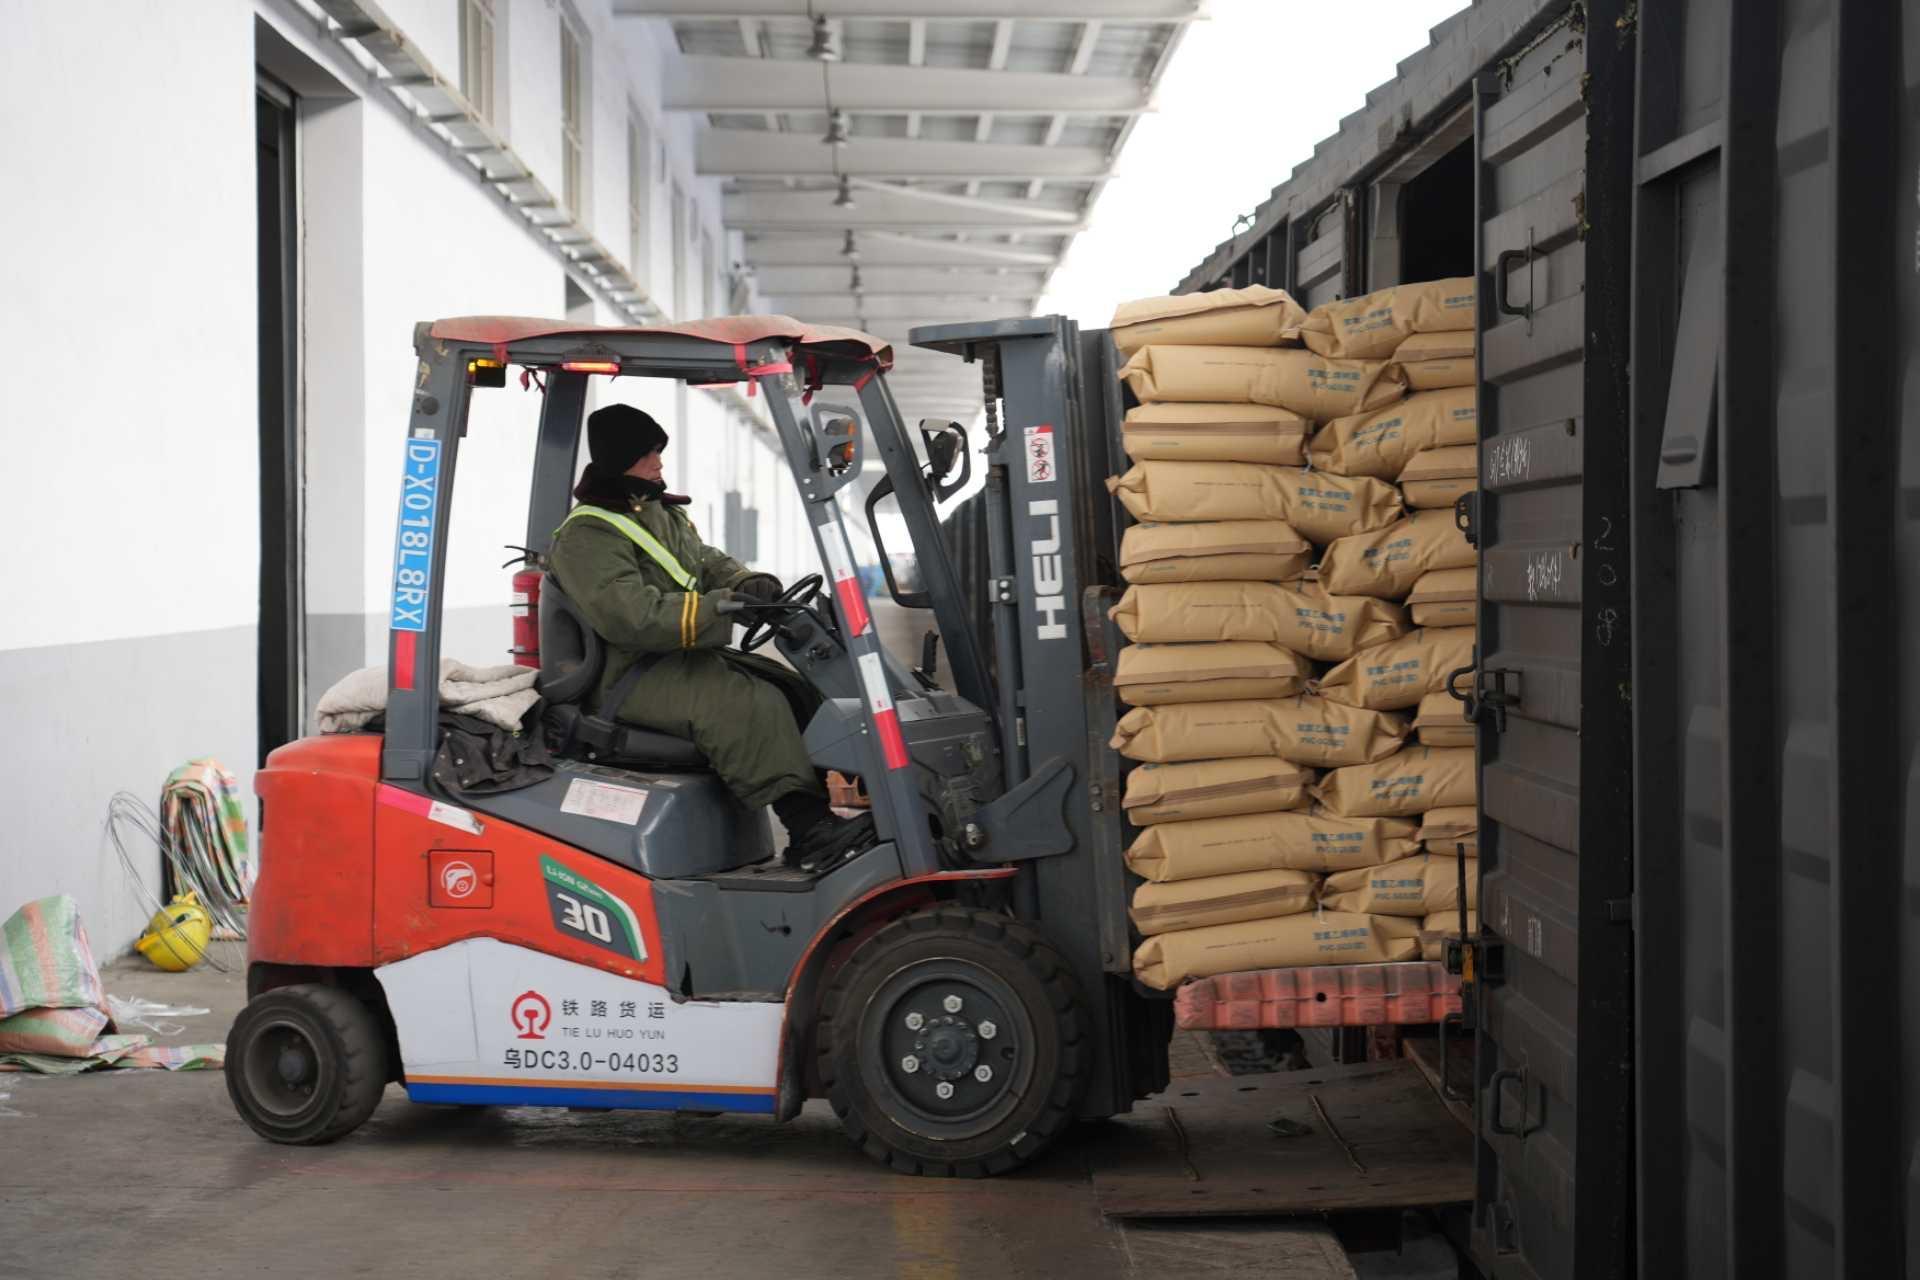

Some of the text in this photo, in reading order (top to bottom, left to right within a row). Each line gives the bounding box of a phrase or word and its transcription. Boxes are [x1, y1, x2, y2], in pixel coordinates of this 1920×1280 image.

[394, 445, 437, 625] D-X018L8RX
[1028, 499, 1067, 640] HELI
[557, 892, 612, 943] 30
[562, 1000, 665, 1019] 铁路货运
[562, 1027, 665, 1040] TIE LU HUO YUN
[504, 1048, 679, 1074] 乌DC3.0-04033
